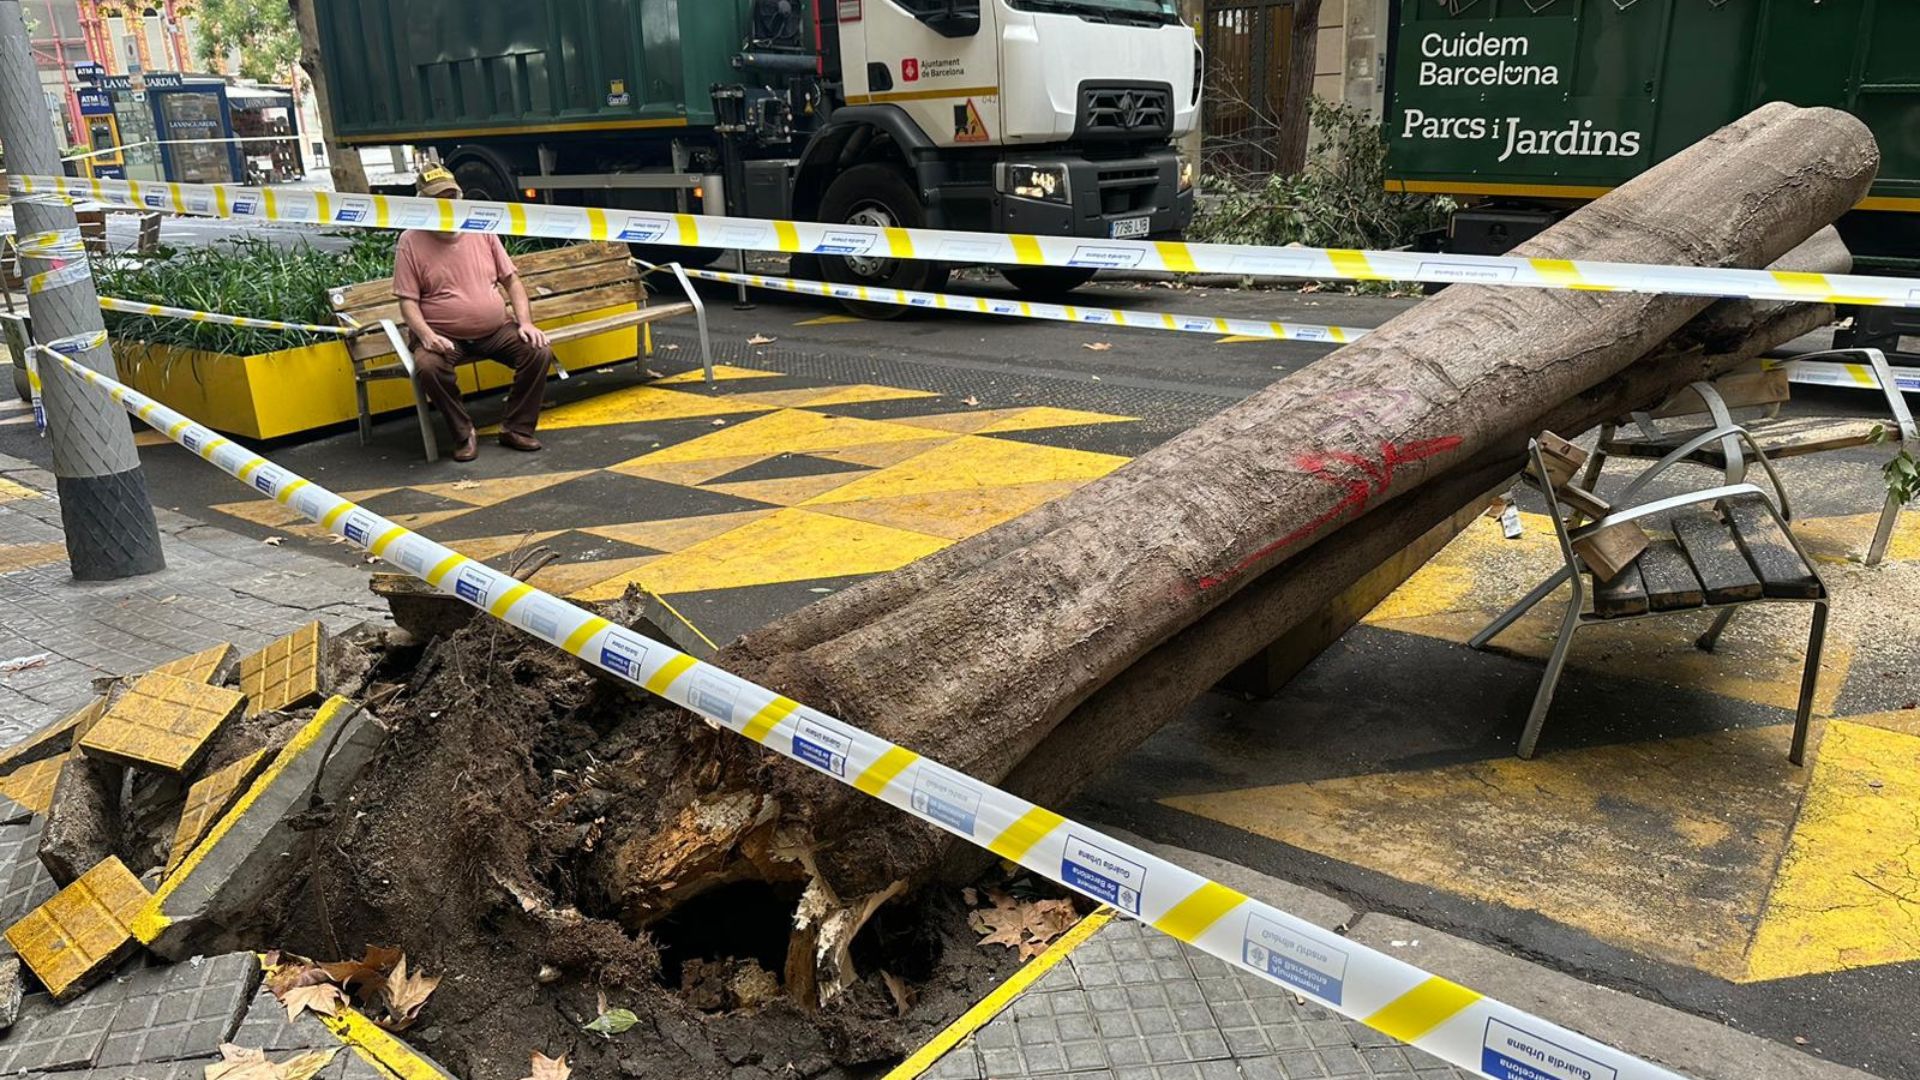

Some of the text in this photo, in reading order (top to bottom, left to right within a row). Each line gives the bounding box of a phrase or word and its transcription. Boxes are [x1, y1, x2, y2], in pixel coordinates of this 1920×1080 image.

[1421, 31, 1529, 58] Cuidem
[921, 58, 960, 70] Ajuntament
[930, 68, 964, 78] Barcelona
[81, 95, 99, 103] ATM
[1401, 108, 1641, 163] Parcs i Jardins
[1114, 220, 1133, 236] 7796
[1078, 850, 1102, 866] Urbana
[1072, 866, 1106, 888] Barcelona
[1076, 879, 1116, 900] Ajuntament
[1506, 1038, 1545, 1062] Urbana
